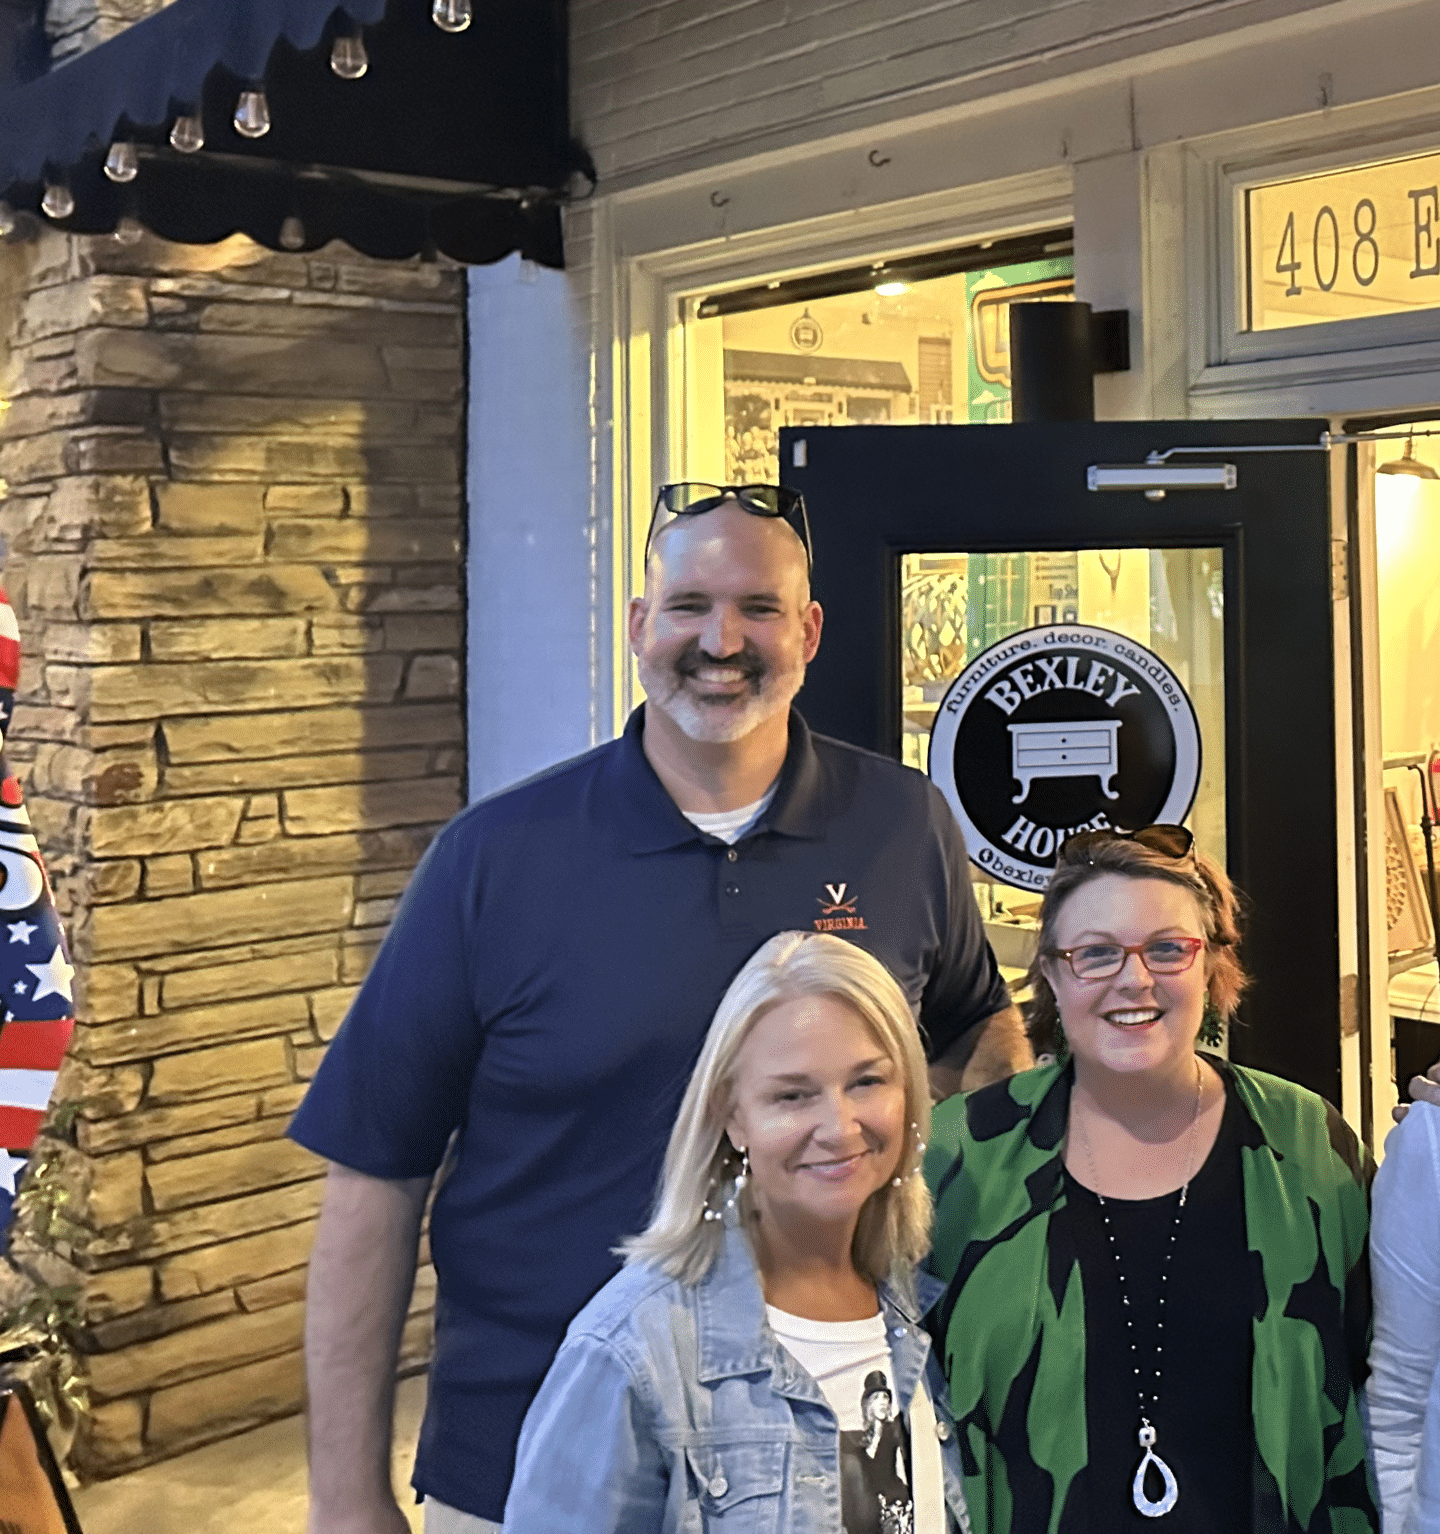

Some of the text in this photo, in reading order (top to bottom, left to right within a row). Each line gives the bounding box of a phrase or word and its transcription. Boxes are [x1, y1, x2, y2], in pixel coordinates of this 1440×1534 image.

[1274, 197, 1381, 298] 408
[946, 632, 1181, 715] furniture. decor. candles.
[984, 655, 1141, 716] BEXLEY
[1001, 811, 1111, 858] HOE
[824, 883, 847, 905] V
[814, 917, 868, 931] VIRGINIA
